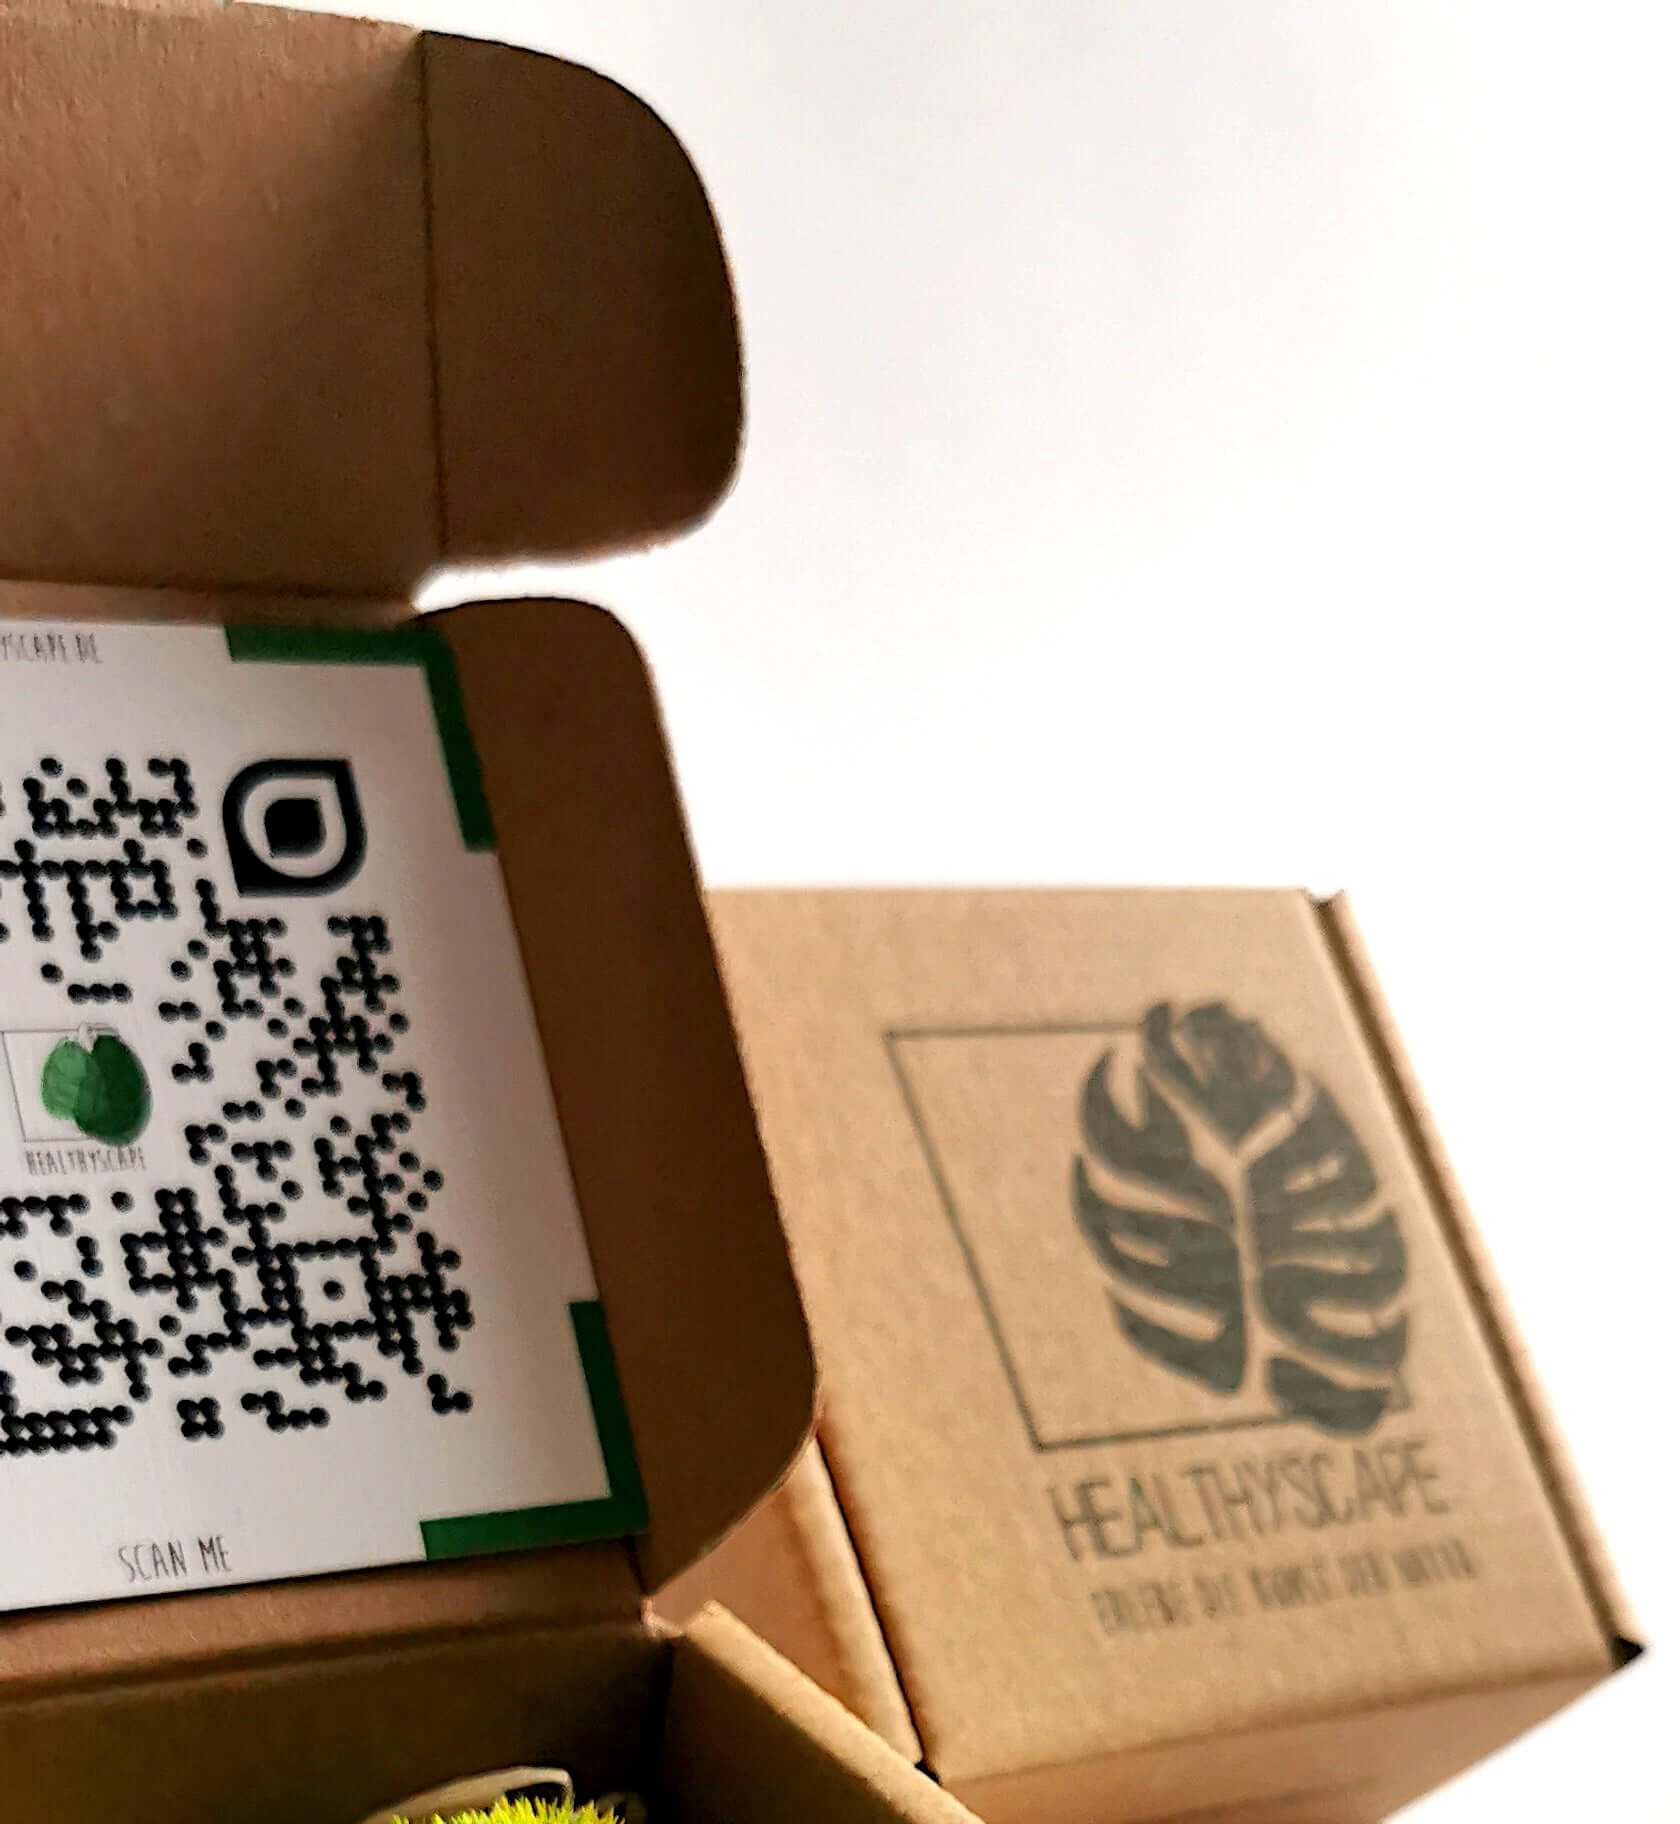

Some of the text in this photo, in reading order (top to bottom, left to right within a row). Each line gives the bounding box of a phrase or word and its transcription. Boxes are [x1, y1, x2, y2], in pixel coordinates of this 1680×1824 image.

[26, 1147, 147, 1175] HEALTHYSCAPE
[1046, 1440, 1452, 1562] HEALTHYSCAPE
[118, 1534, 232, 1582] SCAN ME
